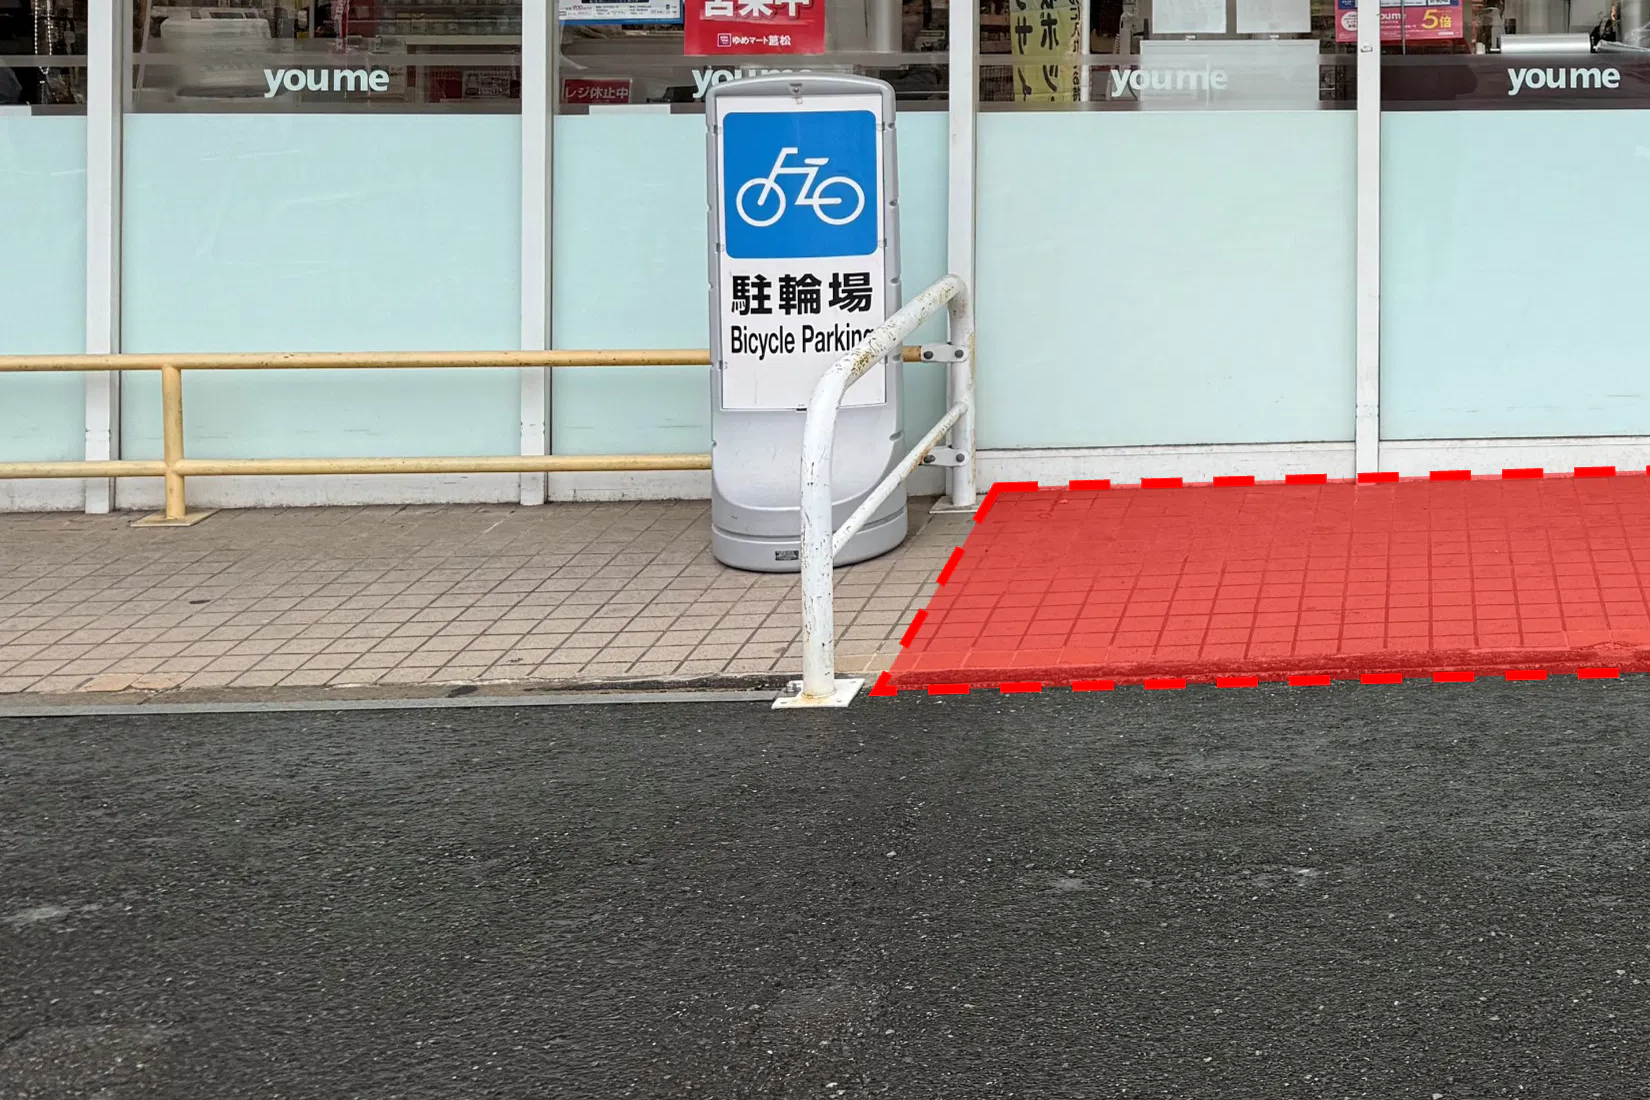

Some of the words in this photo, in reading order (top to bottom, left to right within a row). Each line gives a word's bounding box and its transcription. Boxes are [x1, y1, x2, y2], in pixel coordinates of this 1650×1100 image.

[263, 68, 390, 99] youme
[565, 86, 630, 100] レジ休止中
[1110, 68, 1229, 98] youme
[1507, 66, 1621, 96] youme
[731, 271, 873, 316] 駐輪場
[730, 325, 796, 361] Bicycle
